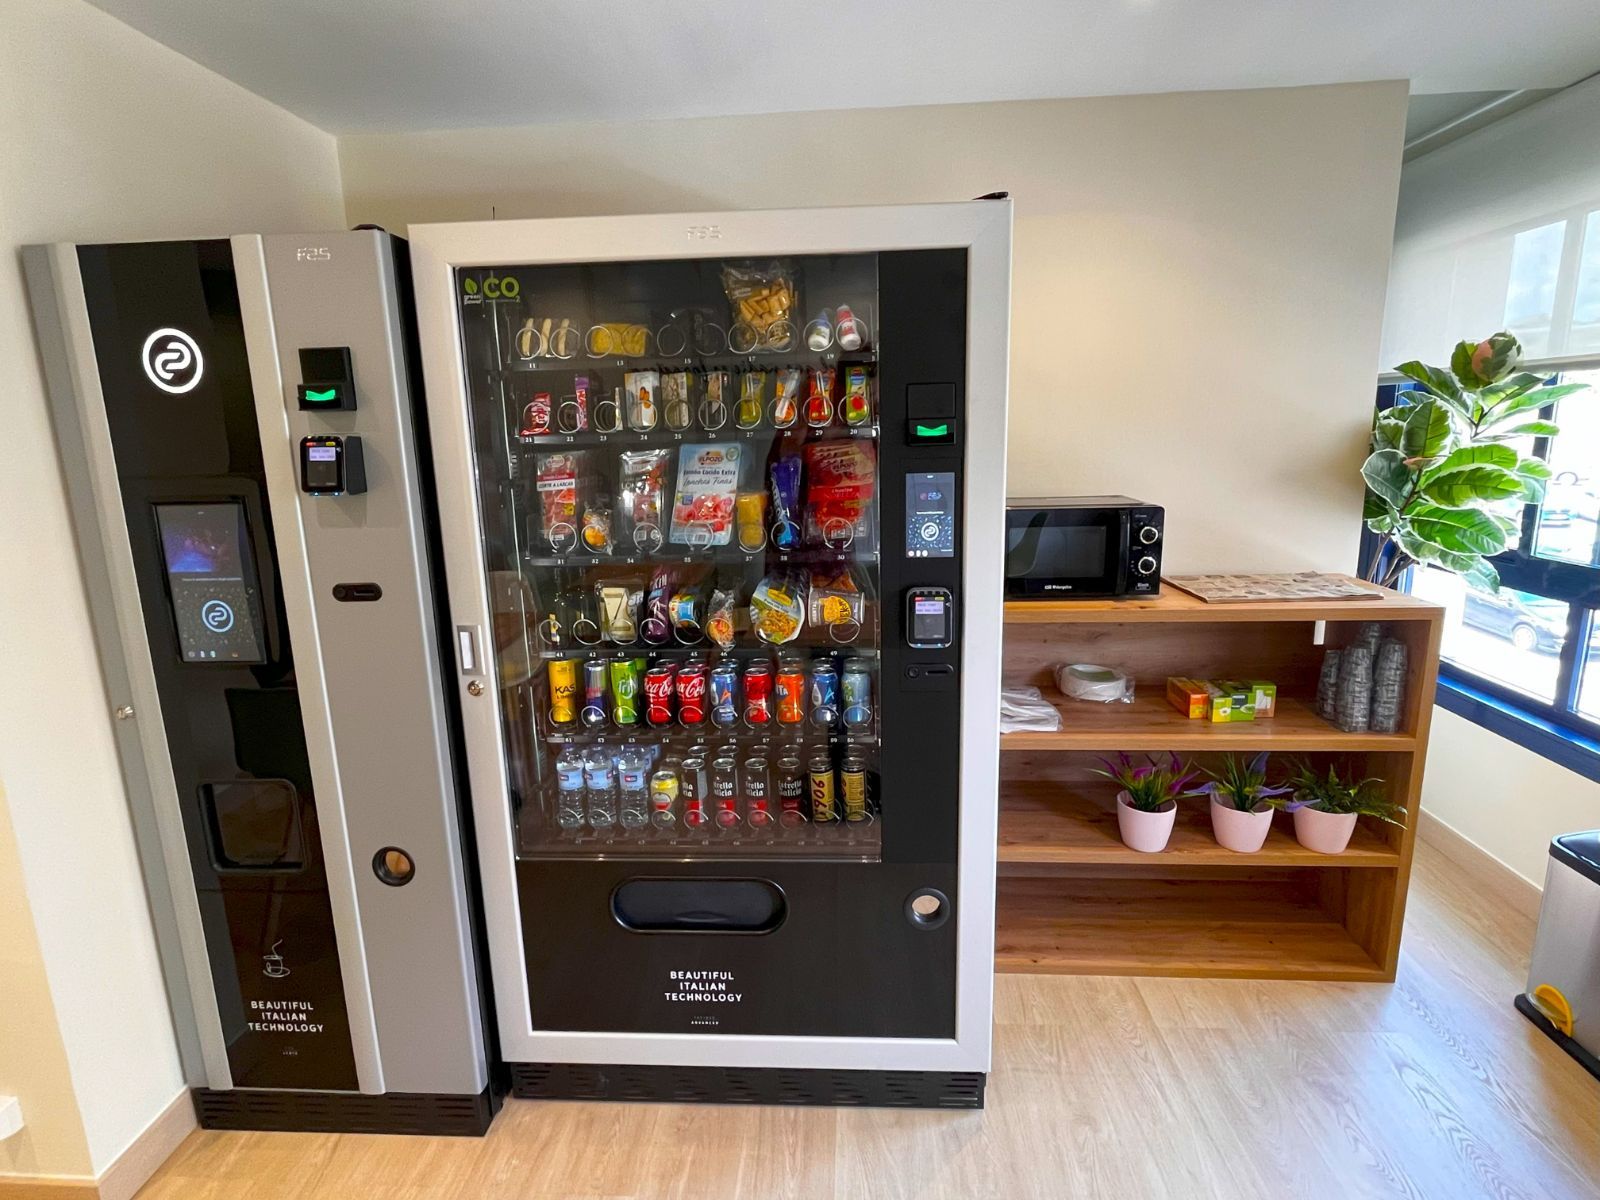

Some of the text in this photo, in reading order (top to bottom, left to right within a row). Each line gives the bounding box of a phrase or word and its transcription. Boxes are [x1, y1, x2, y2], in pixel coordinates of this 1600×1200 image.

[555, 684, 576, 694] KAS
[670, 971, 735, 980] BEAUTIFUL
[680, 982, 726, 991] ITALIAN
[664, 993, 742, 1002] TECHNOLOGY
[251, 1001, 314, 1010] BEAUTIFUL
[262, 1012, 307, 1021] ITALIAN
[248, 1022, 324, 1032] TECHNOLOGY
